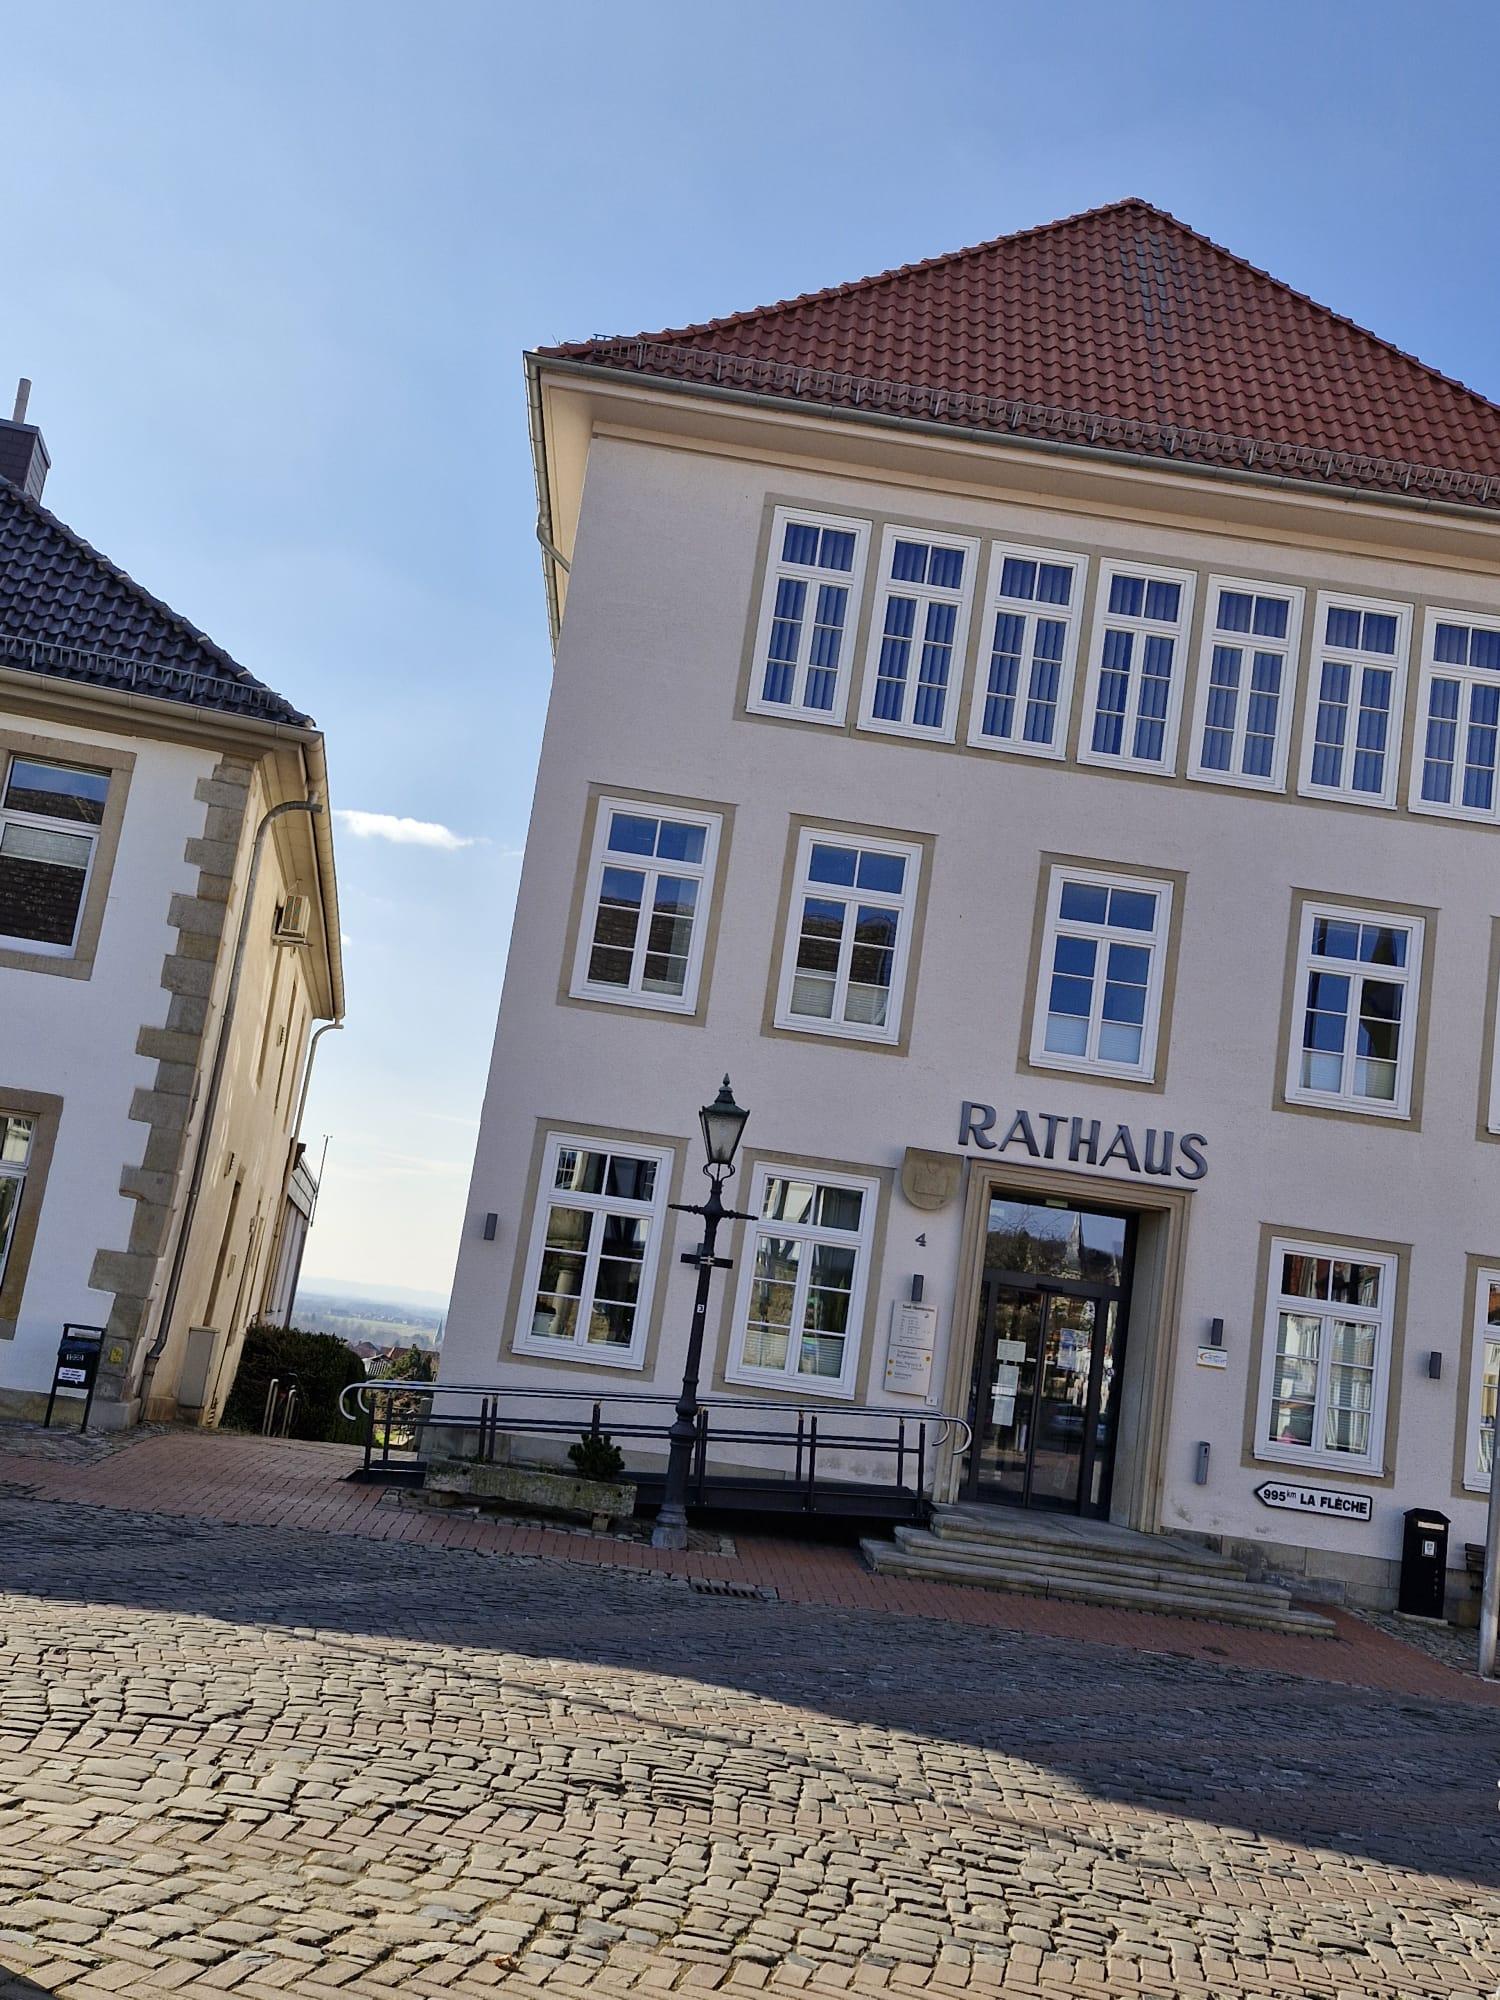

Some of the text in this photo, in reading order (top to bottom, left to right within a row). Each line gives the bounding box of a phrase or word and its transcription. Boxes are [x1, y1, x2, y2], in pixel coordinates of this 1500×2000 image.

[957, 1100, 1209, 1181] RATHAUS
[914, 1232, 928, 1248] 4
[1300, 1493, 1316, 1507] LA
[1320, 1495, 1368, 1514] FLÈCHE
